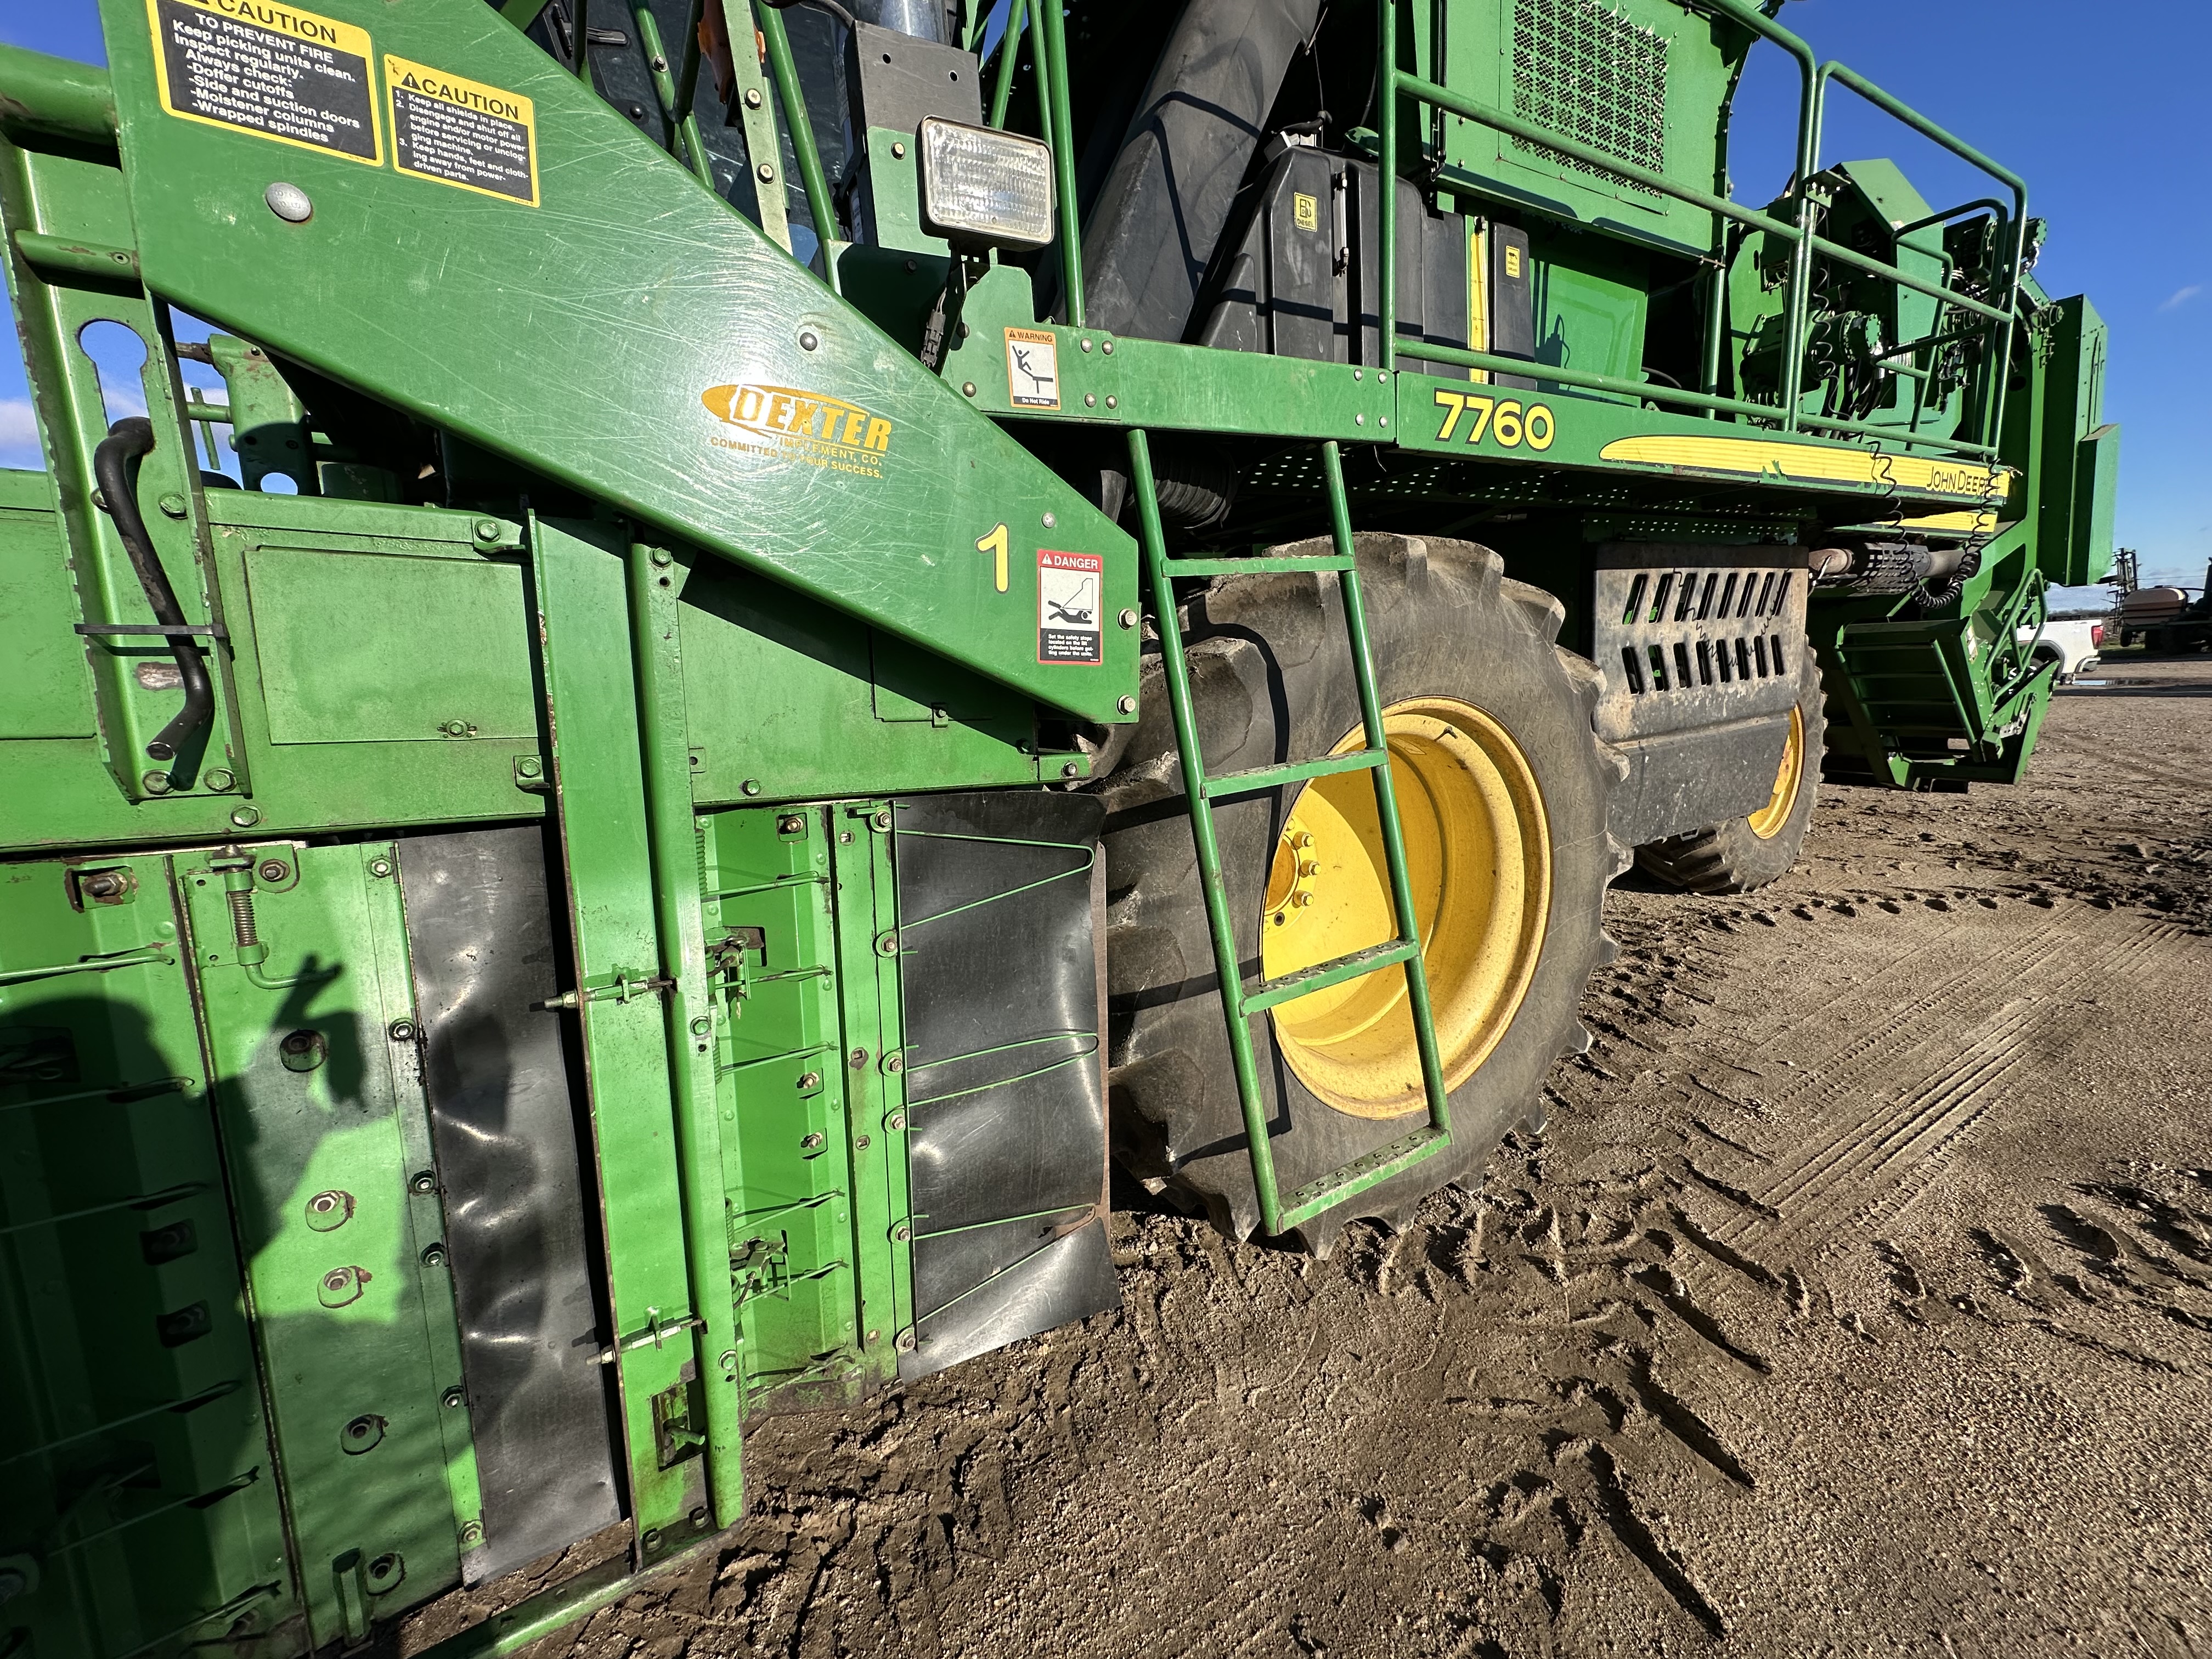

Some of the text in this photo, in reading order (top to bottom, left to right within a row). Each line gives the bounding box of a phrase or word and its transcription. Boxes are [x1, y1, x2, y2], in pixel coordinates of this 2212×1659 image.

[195, 13, 334, 64] TO PREVENT FIRE
[218, 0, 336, 43] CAUTION
[173, 19, 356, 83] Keep picking units clean.
[174, 32, 303, 80] Inspect regularly.
[185, 48, 292, 87] Always check:
[187, 62, 295, 99] -Doffer cutoffs
[189, 75, 360, 128] -Side and suction doors
[422, 79, 518, 120] CAUTION
[190, 87, 335, 133] -Moistener columns
[192, 99, 329, 143] -Wrapped spindles
[395, 90, 515, 132] 1. Keep all shields in place.
[396, 99, 521, 142] 2. Disengage and shut off all
[409, 114, 526, 151] engine and/or motor power
[410, 122, 439, 137] before
[442, 132, 482, 150] servicing
[494, 147, 526, 161] unclog-
[411, 133, 473, 155] ging machine.
[399, 137, 528, 179] 3. Keep hands, feet and cloth-
[413, 150, 506, 181] ing away from power-
[413, 161, 470, 181] driven parts.
[1297, 218, 1314, 227] DIESEL
[1017, 331, 1052, 342] WARNING
[733, 387, 891, 452] DEXTER
[1434, 387, 1555, 452] 7760
[710, 437, 883, 479] COMMITTED TO YOUR SUCCESS.
[780, 437, 882, 466] IMPLEMENT, CO.
[1926, 466, 1956, 490] JOHN
[975, 522, 1009, 594] 1
[1054, 555, 1098, 569] DANGER
